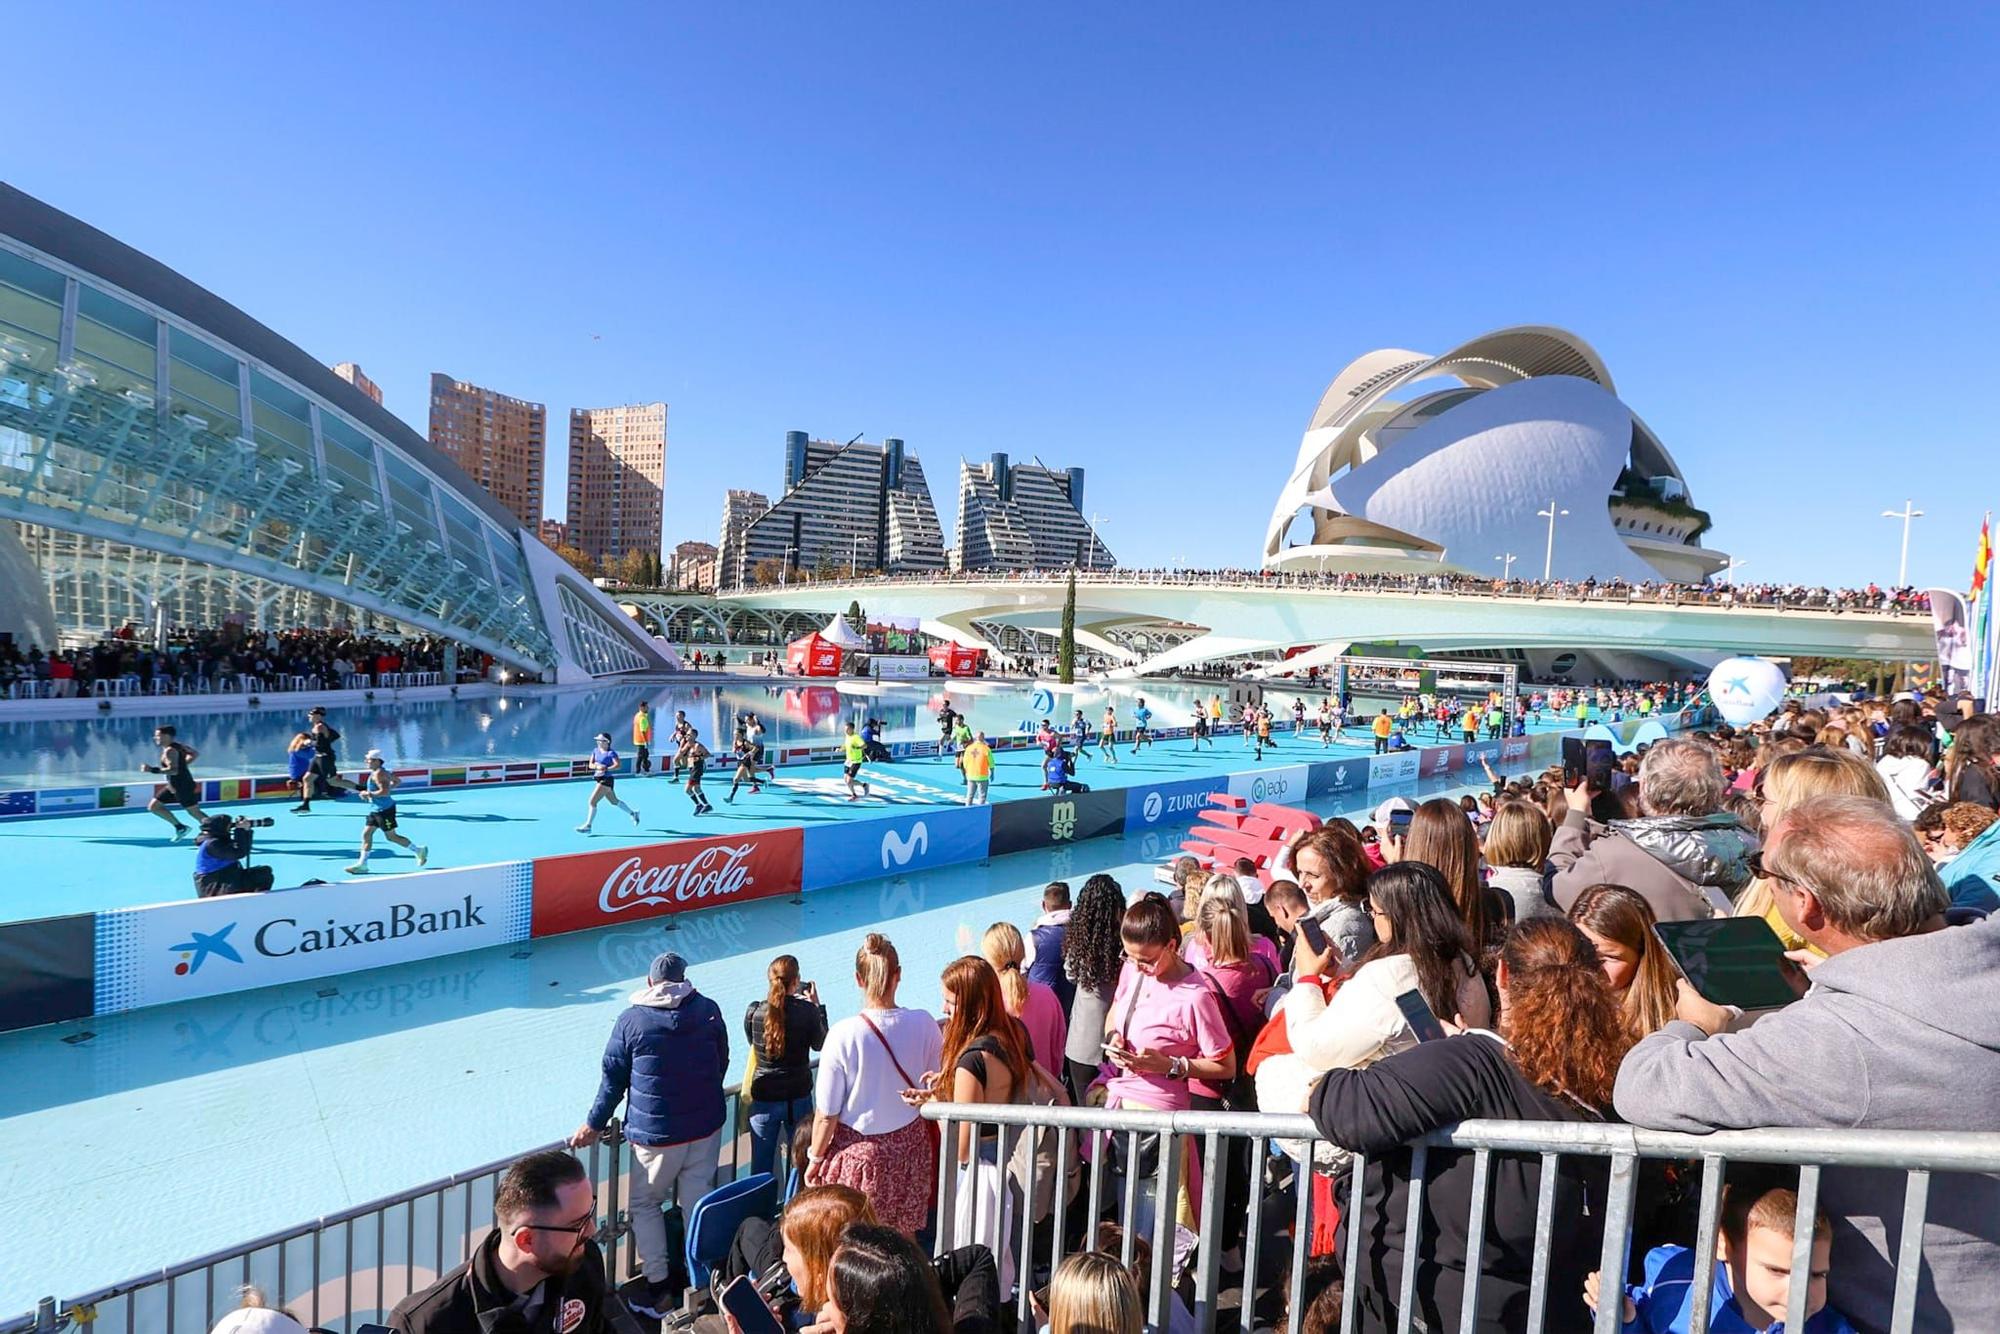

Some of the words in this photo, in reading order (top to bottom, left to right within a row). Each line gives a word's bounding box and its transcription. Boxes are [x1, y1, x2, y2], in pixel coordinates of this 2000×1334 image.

[1267, 773, 1287, 800] edp
[598, 842, 758, 913] Coca-Cola
[254, 895, 487, 957] CaixaBank
